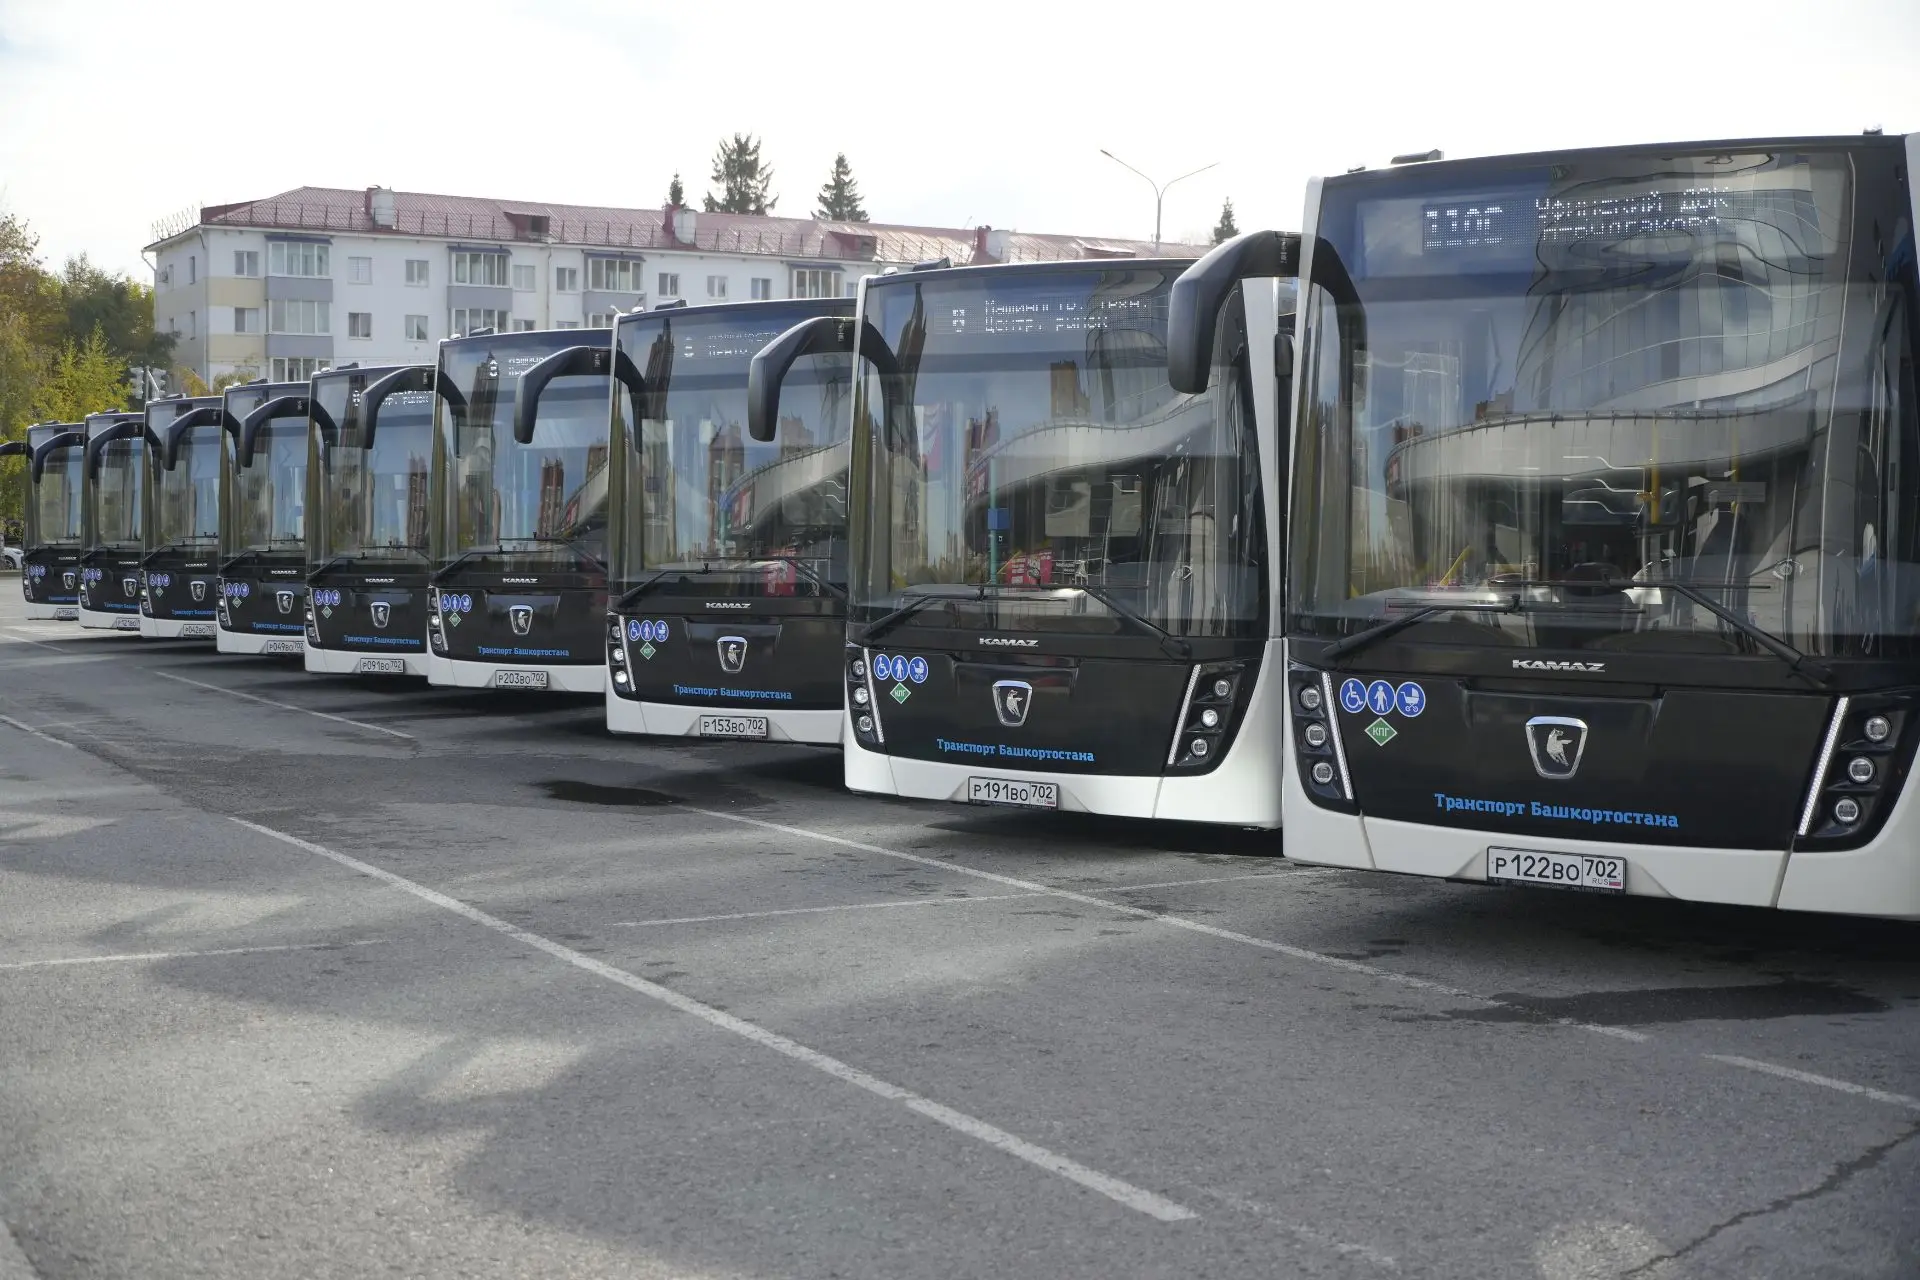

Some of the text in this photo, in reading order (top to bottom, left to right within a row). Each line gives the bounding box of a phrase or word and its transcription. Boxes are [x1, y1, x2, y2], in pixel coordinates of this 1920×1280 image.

[343, 634, 421, 645] Транспорт Башкортостана
[978, 637, 1040, 647] KAMAZ
[478, 646, 570, 657] Транспорт Башкортостана
[1512, 659, 1606, 672] KAMAZ
[531, 672, 545, 682] 702
[673, 684, 793, 700] Транспорт Башкортостана
[747, 718, 764, 730] 702
[1372, 727, 1390, 739] КПГ
[937, 738, 1095, 762] Транспорт Башкортостана
[1031, 784, 1053, 799] 702
[1434, 793, 1679, 828] Транспорт Башкортостана
[1584, 859, 1618, 879] 702
[1592, 878, 1609, 886] RUS
